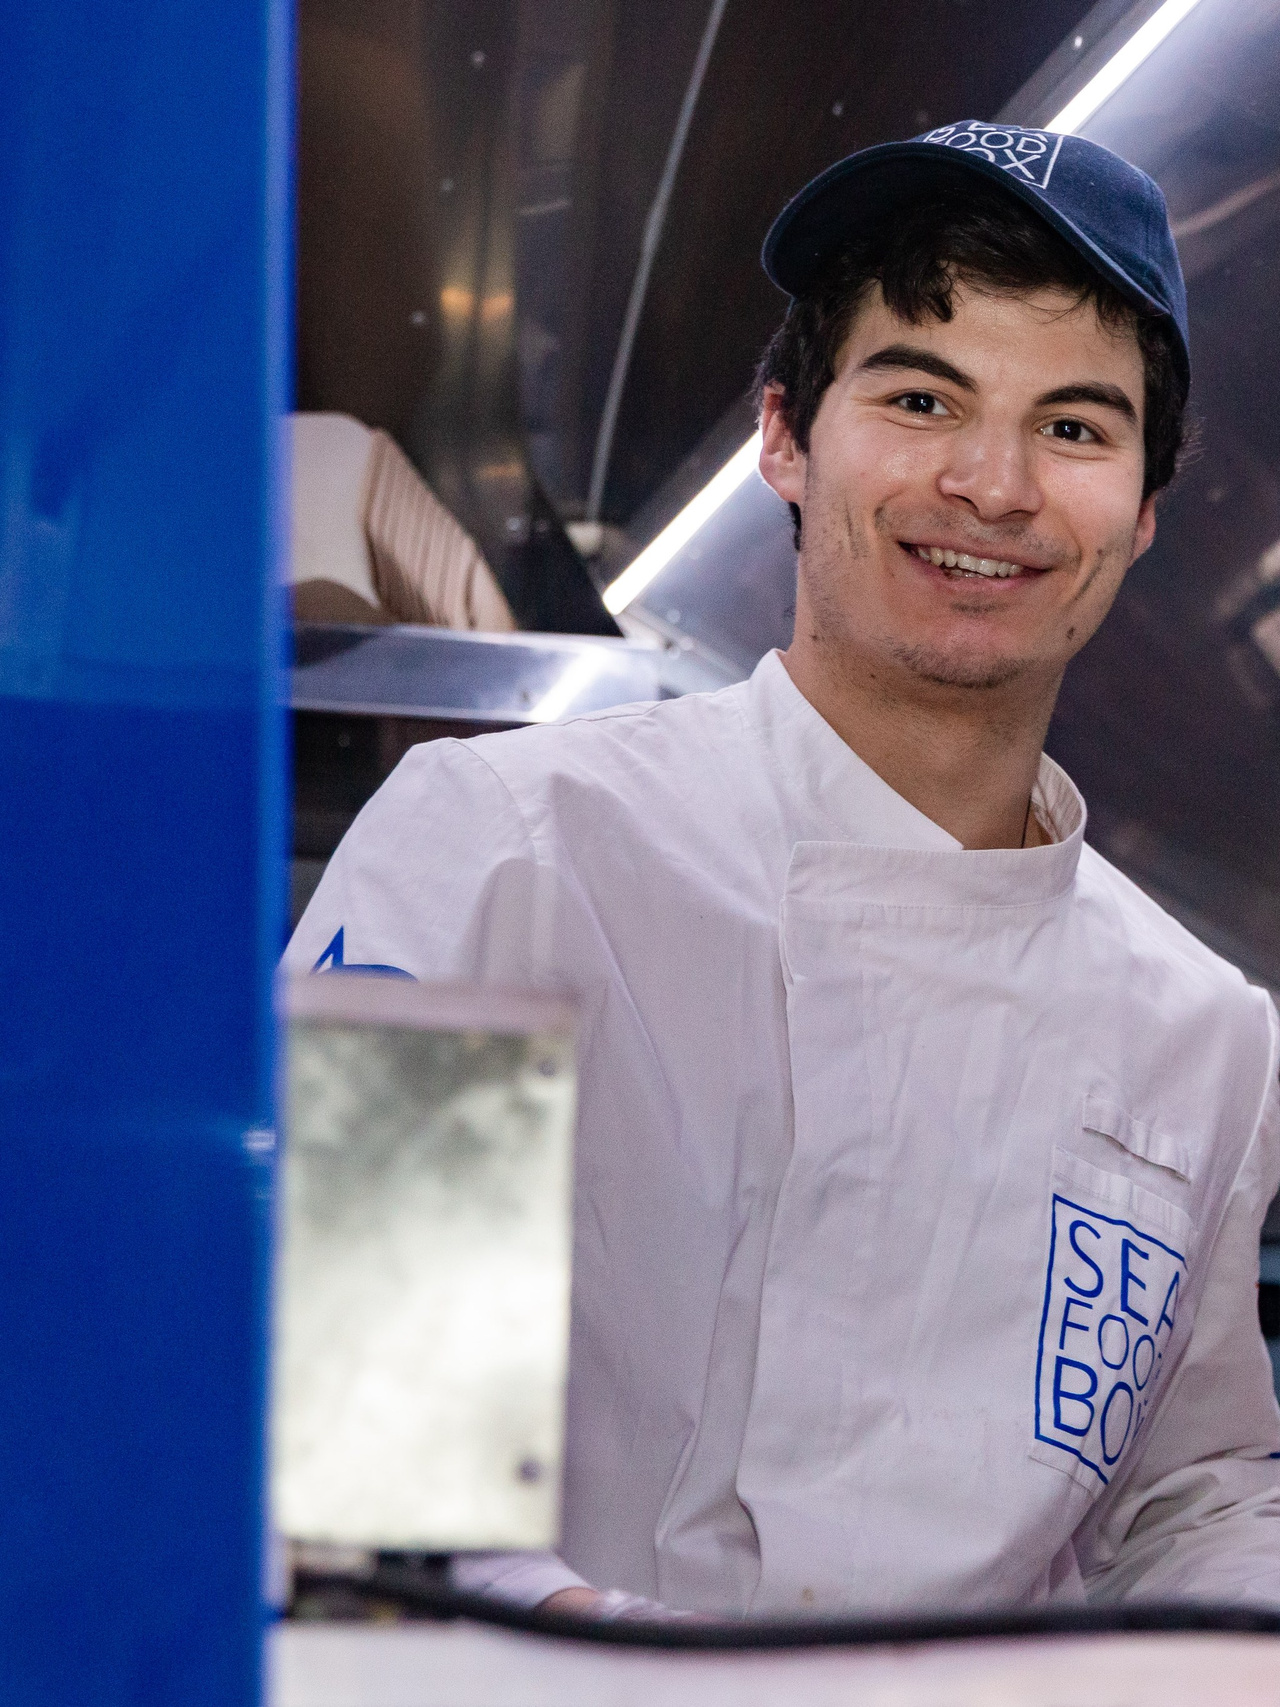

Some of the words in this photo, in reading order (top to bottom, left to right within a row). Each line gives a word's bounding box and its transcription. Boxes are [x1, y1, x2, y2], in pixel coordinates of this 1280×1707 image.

[937, 131, 1047, 154] OOD
[1063, 1219, 1180, 1335] SEA
[1058, 1296, 1162, 1392] FOO
